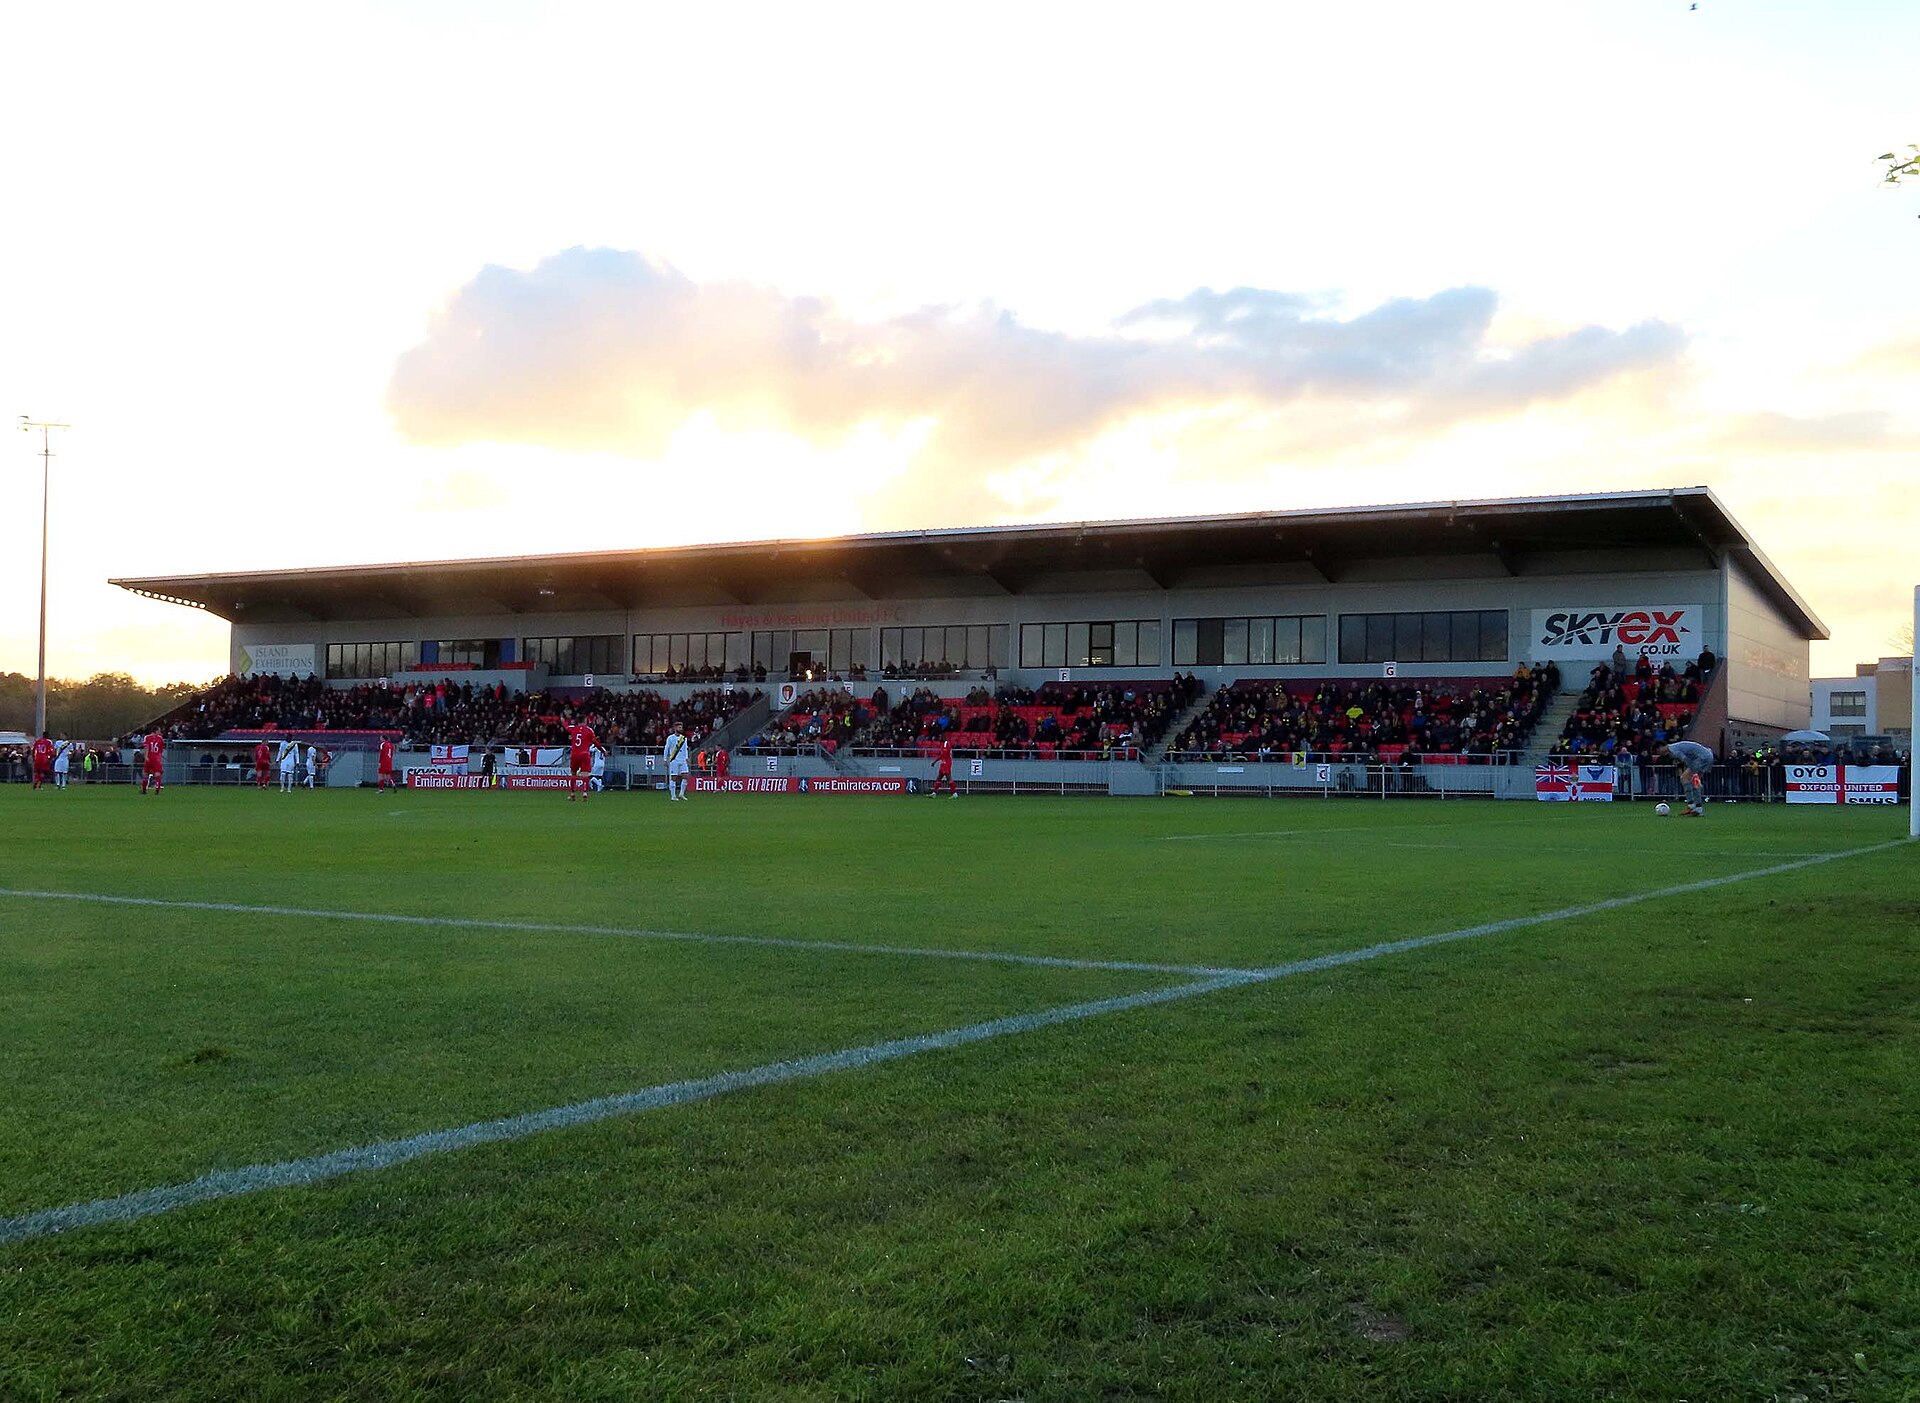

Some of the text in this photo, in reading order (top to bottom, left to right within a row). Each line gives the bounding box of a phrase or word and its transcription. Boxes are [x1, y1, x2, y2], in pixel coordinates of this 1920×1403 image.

[255, 647, 288, 658] ISLAND
[255, 658, 313, 669] EXHIBITIONS
[1386, 667, 1394, 676] G
[575, 733, 582, 747] 5
[150, 742, 159, 753] 16
[1793, 767, 1827, 778] OYO
[415, 775, 454, 788] Emirates
[512, 778, 525, 787] THE
[525, 777, 558, 788] Emirates
[695, 777, 788, 791] Emiates FLY BETTER
[813, 779, 901, 791] THE Emirates FA CUP
